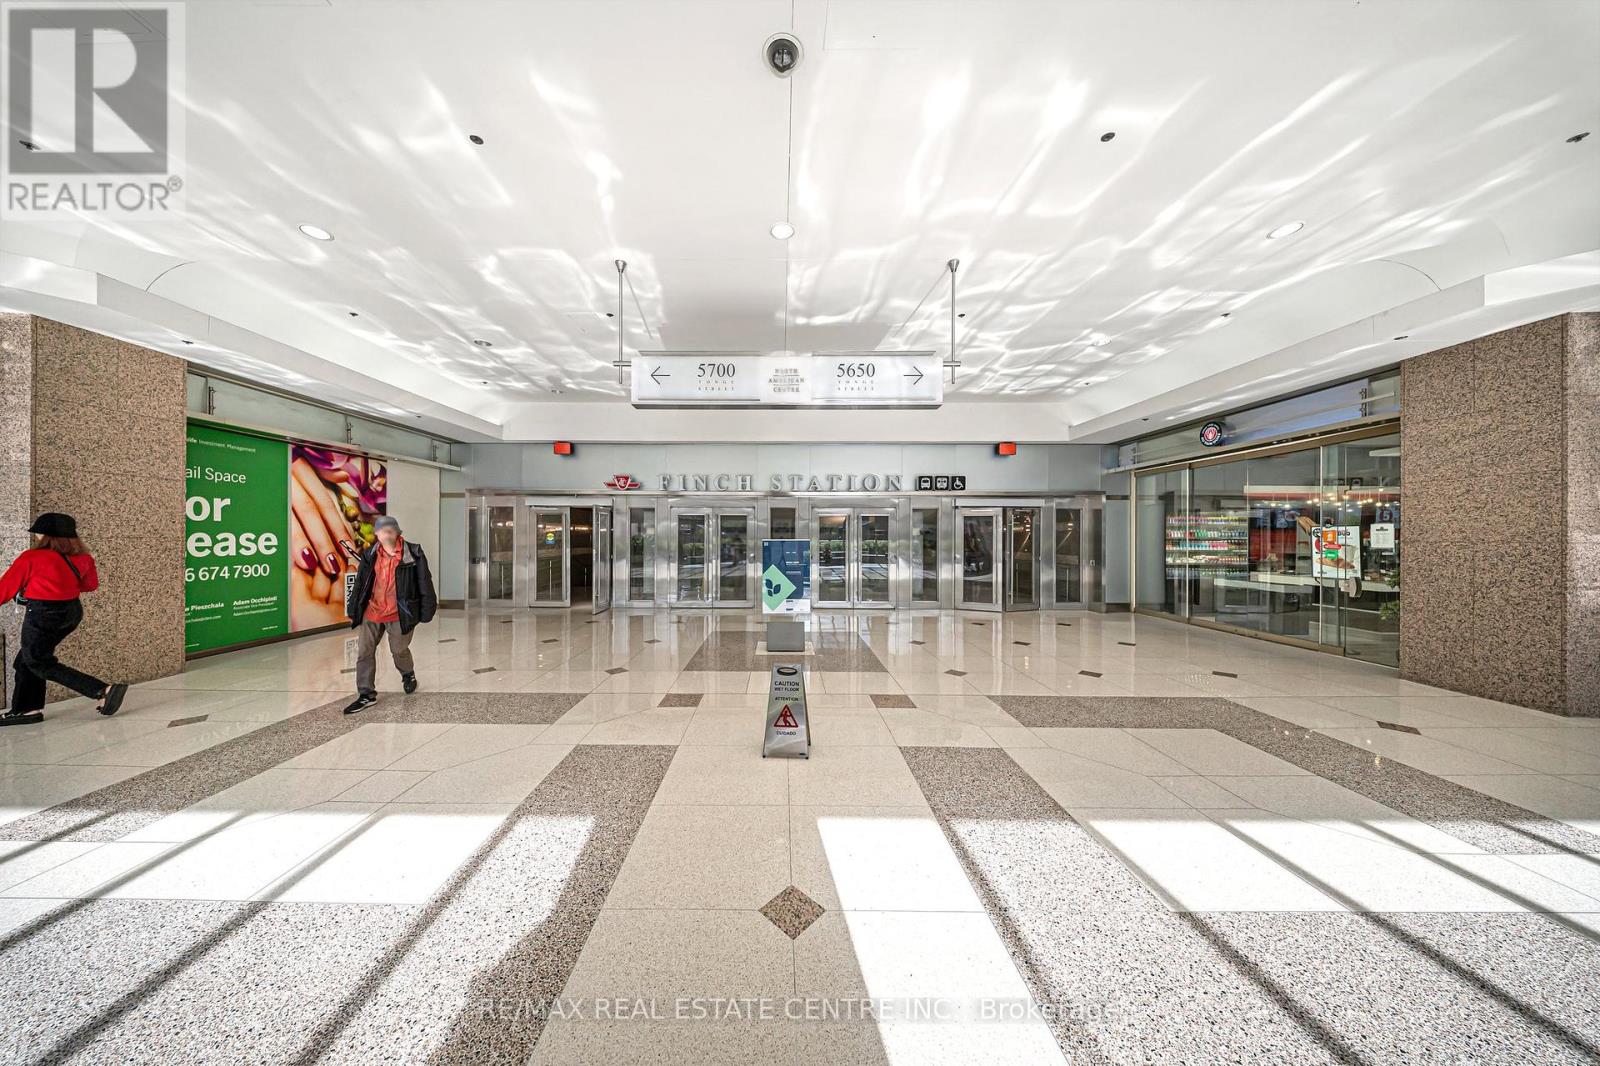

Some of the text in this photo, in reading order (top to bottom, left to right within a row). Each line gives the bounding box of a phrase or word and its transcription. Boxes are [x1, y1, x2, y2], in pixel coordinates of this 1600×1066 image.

[697, 362, 736, 378] 5700
[836, 362, 876, 378] 5650
[204, 467, 247, 484] Space
[657, 474, 903, 492] FINCH STATION
[185, 495, 231, 522] or
[186, 532, 279, 558] ease
[198, 565, 230, 581] 674
[232, 563, 270, 579] 7900
